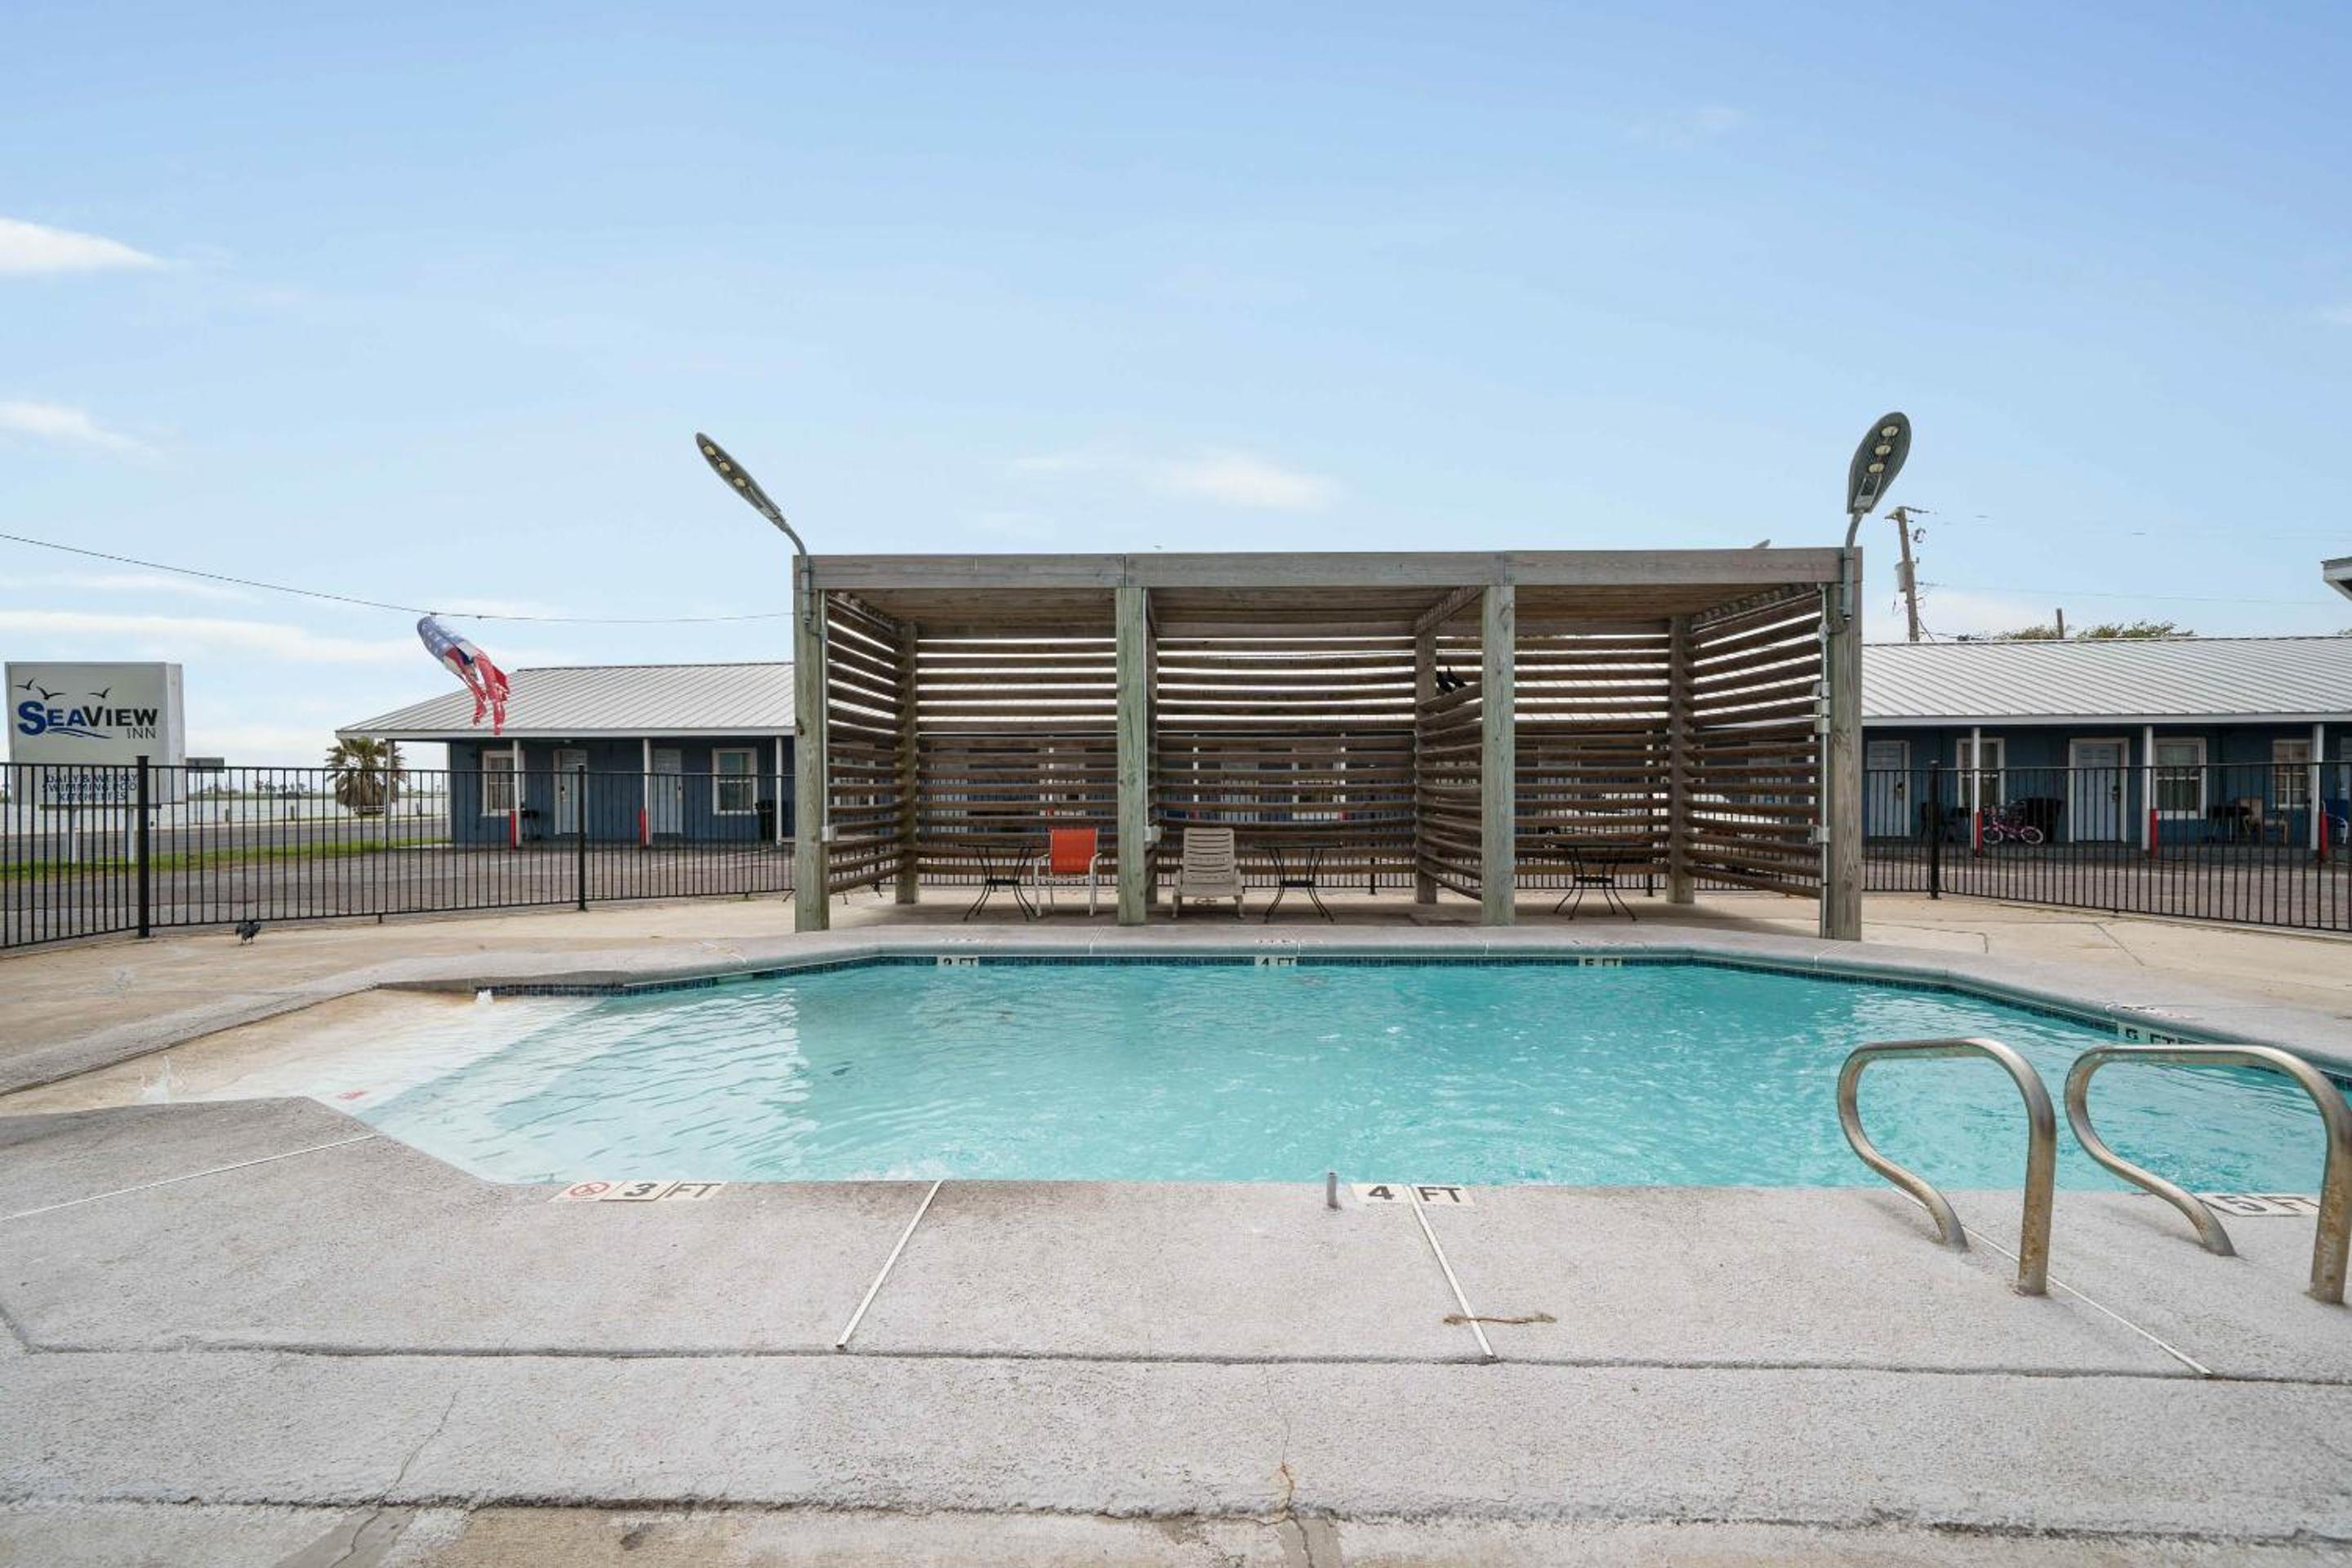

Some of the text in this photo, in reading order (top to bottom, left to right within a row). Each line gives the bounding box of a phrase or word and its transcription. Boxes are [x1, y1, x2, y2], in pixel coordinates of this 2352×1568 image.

[17, 701, 158, 736] SEAVIEW
[127, 728, 157, 739] INN
[623, 1183, 724, 1199] 3 FT
[1367, 1185, 1461, 1203] 4 FT
[2214, 1195, 2268, 1212] 5
